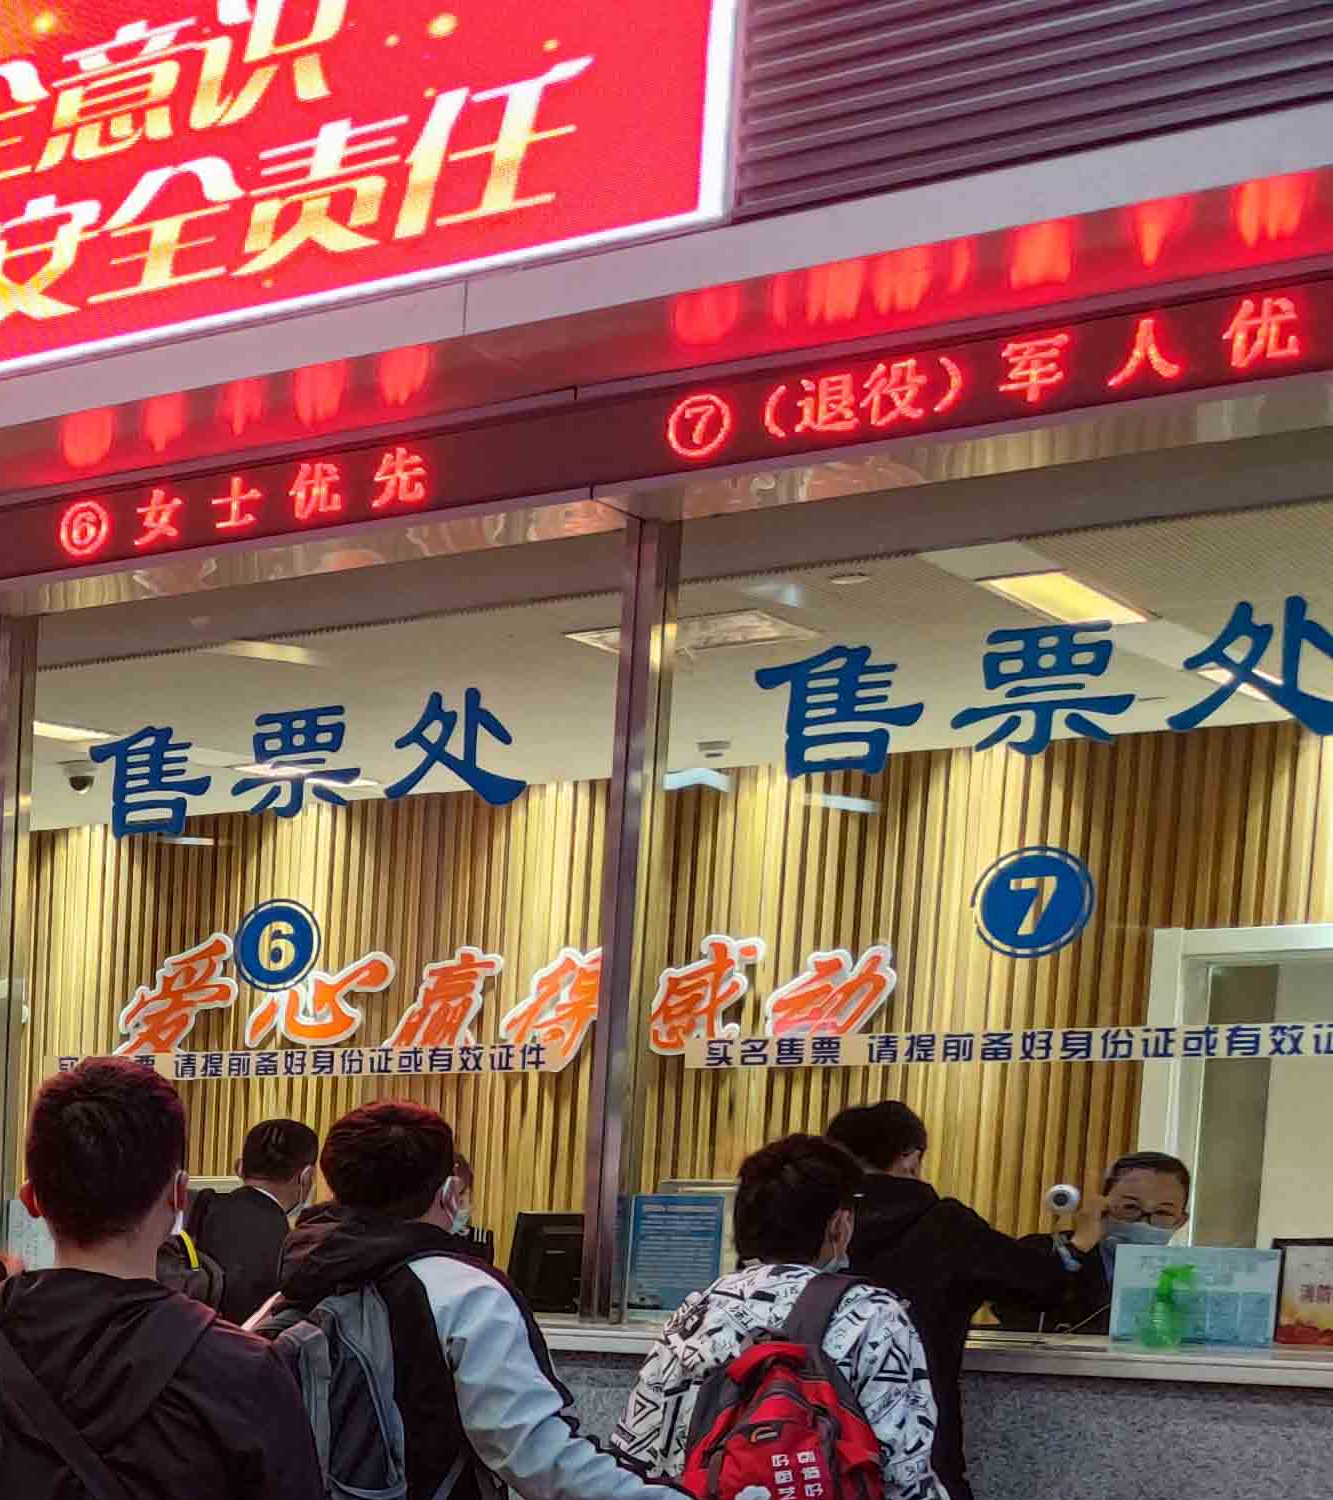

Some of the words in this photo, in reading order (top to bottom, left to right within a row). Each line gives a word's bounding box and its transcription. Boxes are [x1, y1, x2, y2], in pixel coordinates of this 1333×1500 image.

[133, 448, 432, 547] 女士优先
[755, 593, 1333, 781] 售票处
[88, 686, 527, 839] 售票处
[174, 1045, 547, 1078] 请提前备好身份证或有效证件
[705, 1039, 843, 1066] 实名售票
